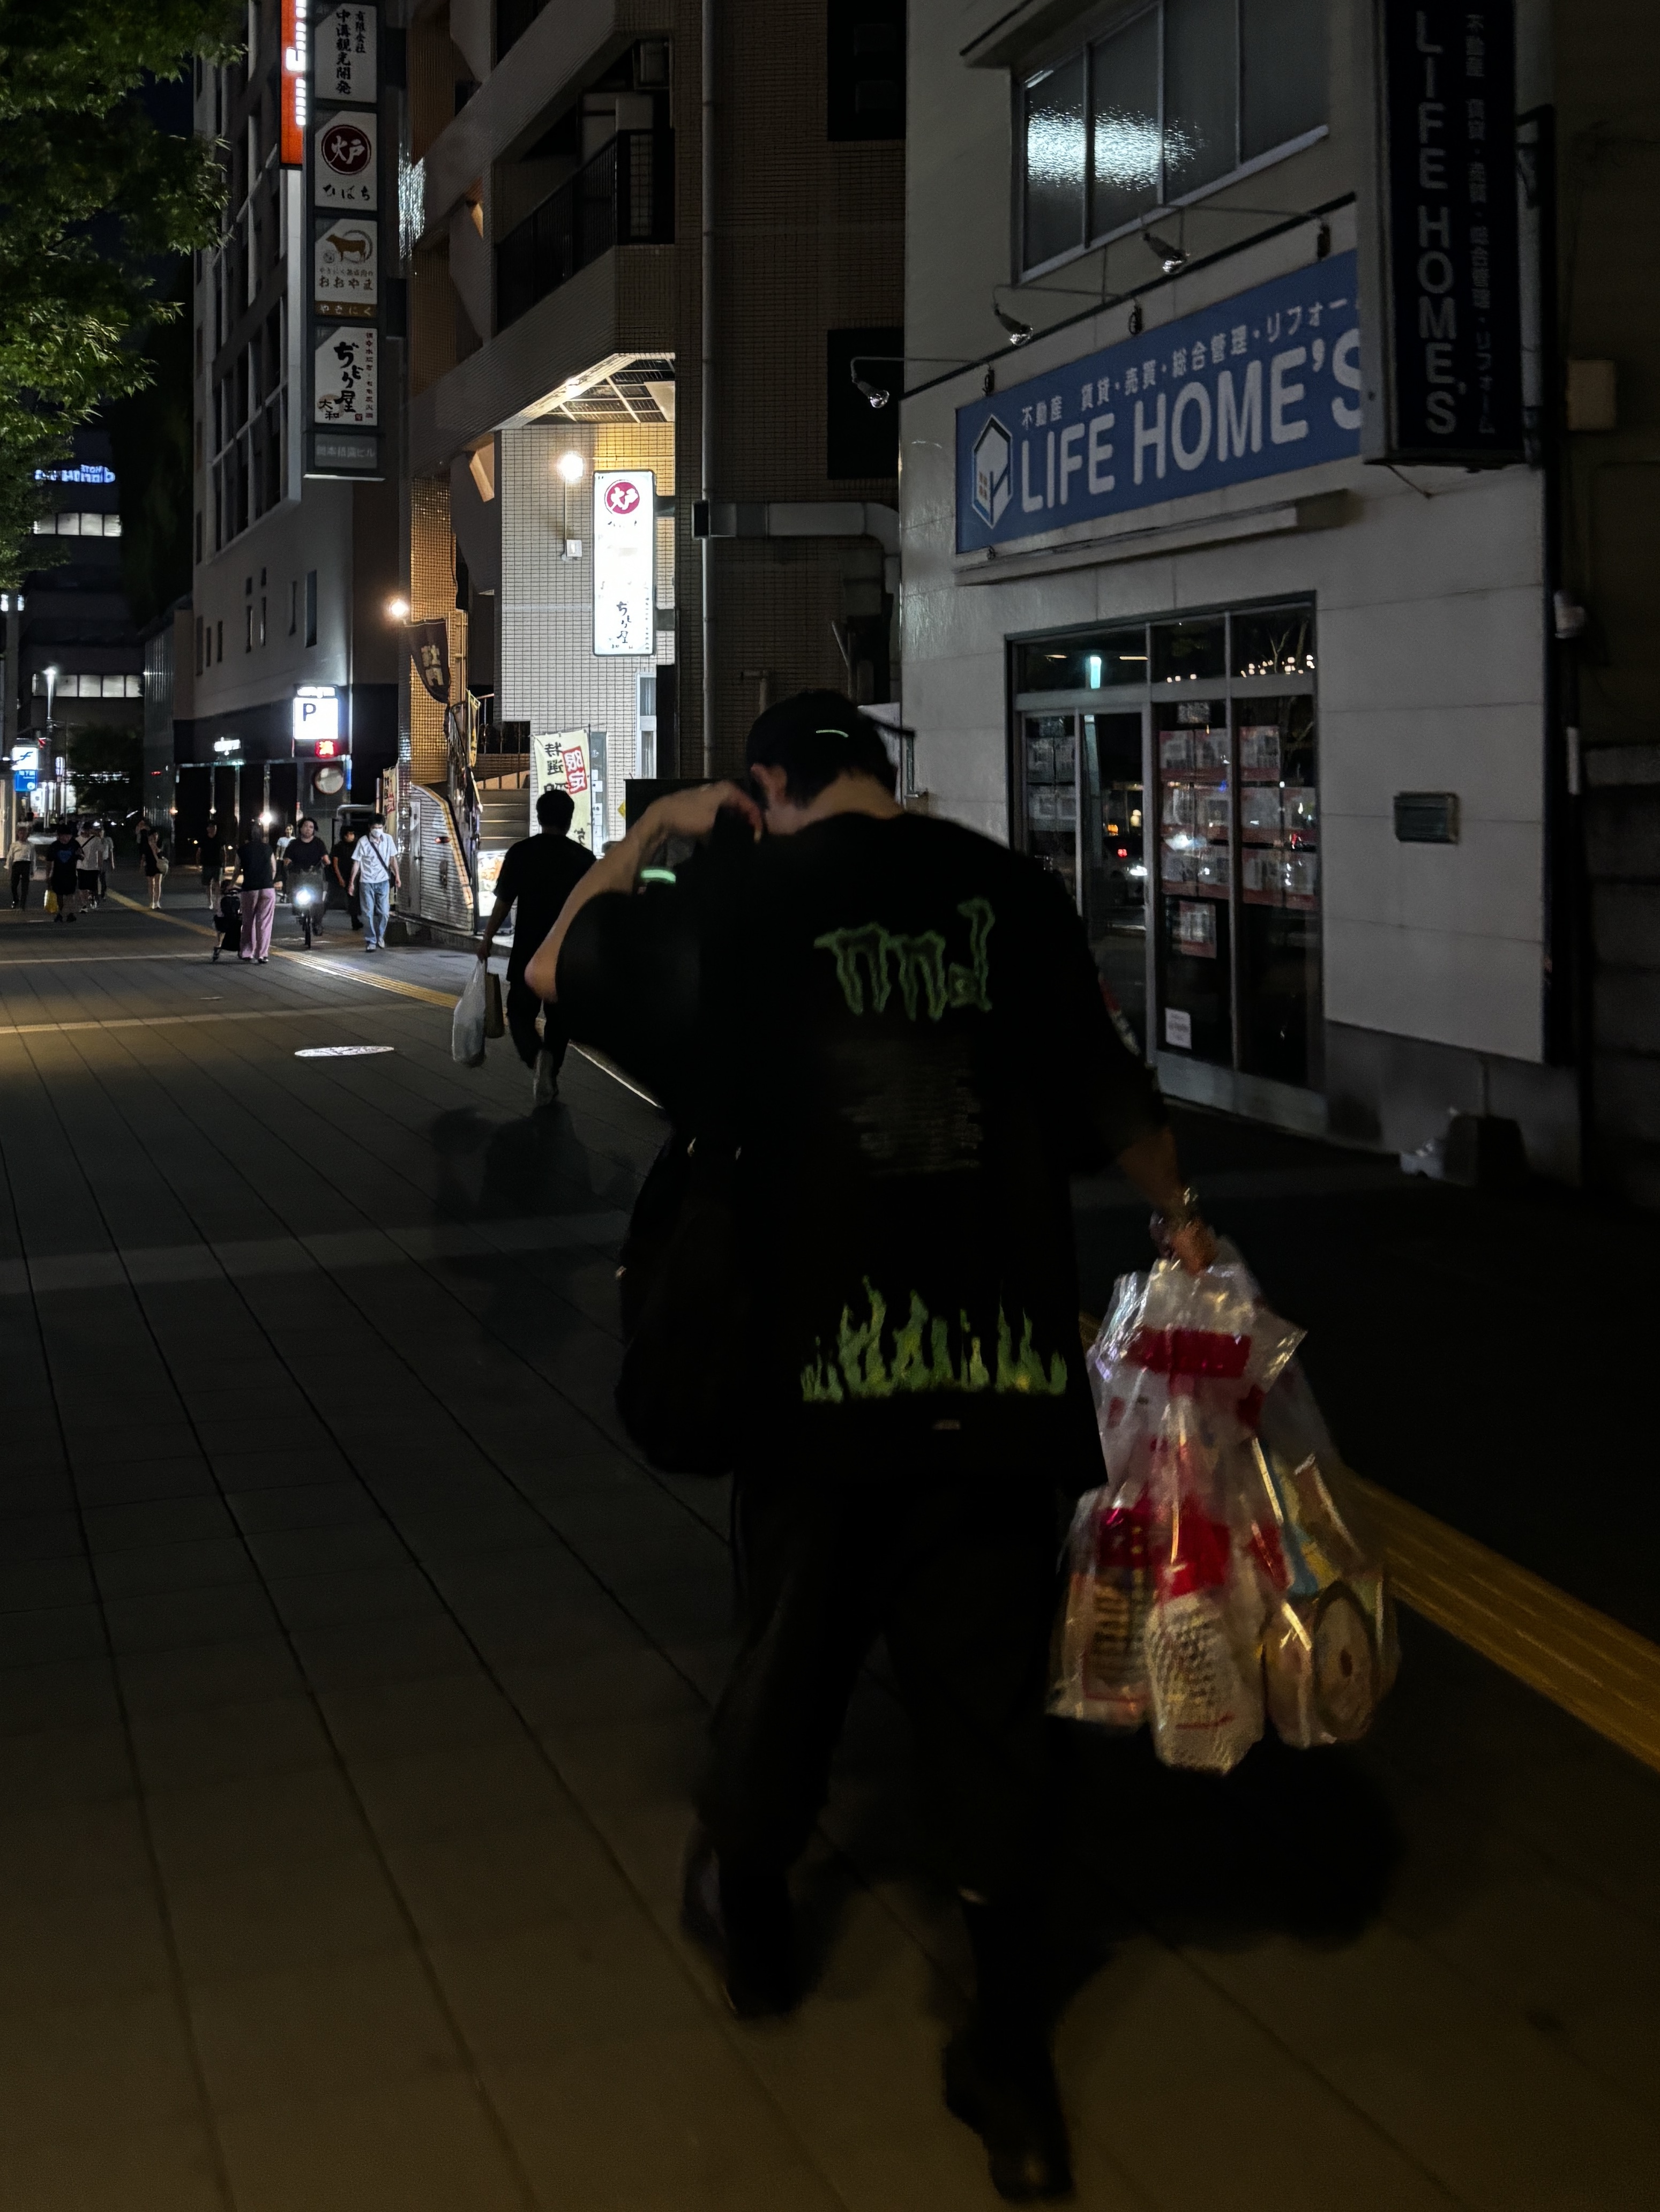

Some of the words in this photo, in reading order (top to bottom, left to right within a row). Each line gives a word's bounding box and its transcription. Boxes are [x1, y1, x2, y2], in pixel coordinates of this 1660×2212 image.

[355, 11, 366, 54] 有限会社
[1416, 10, 1448, 190] LIFE
[1080, 297, 1359, 411] 賃貸・売買・総合管理・リフォー
[319, 399, 340, 421] 大和
[1021, 413, 1116, 514] LIFE
[303, 703, 317, 722] P
